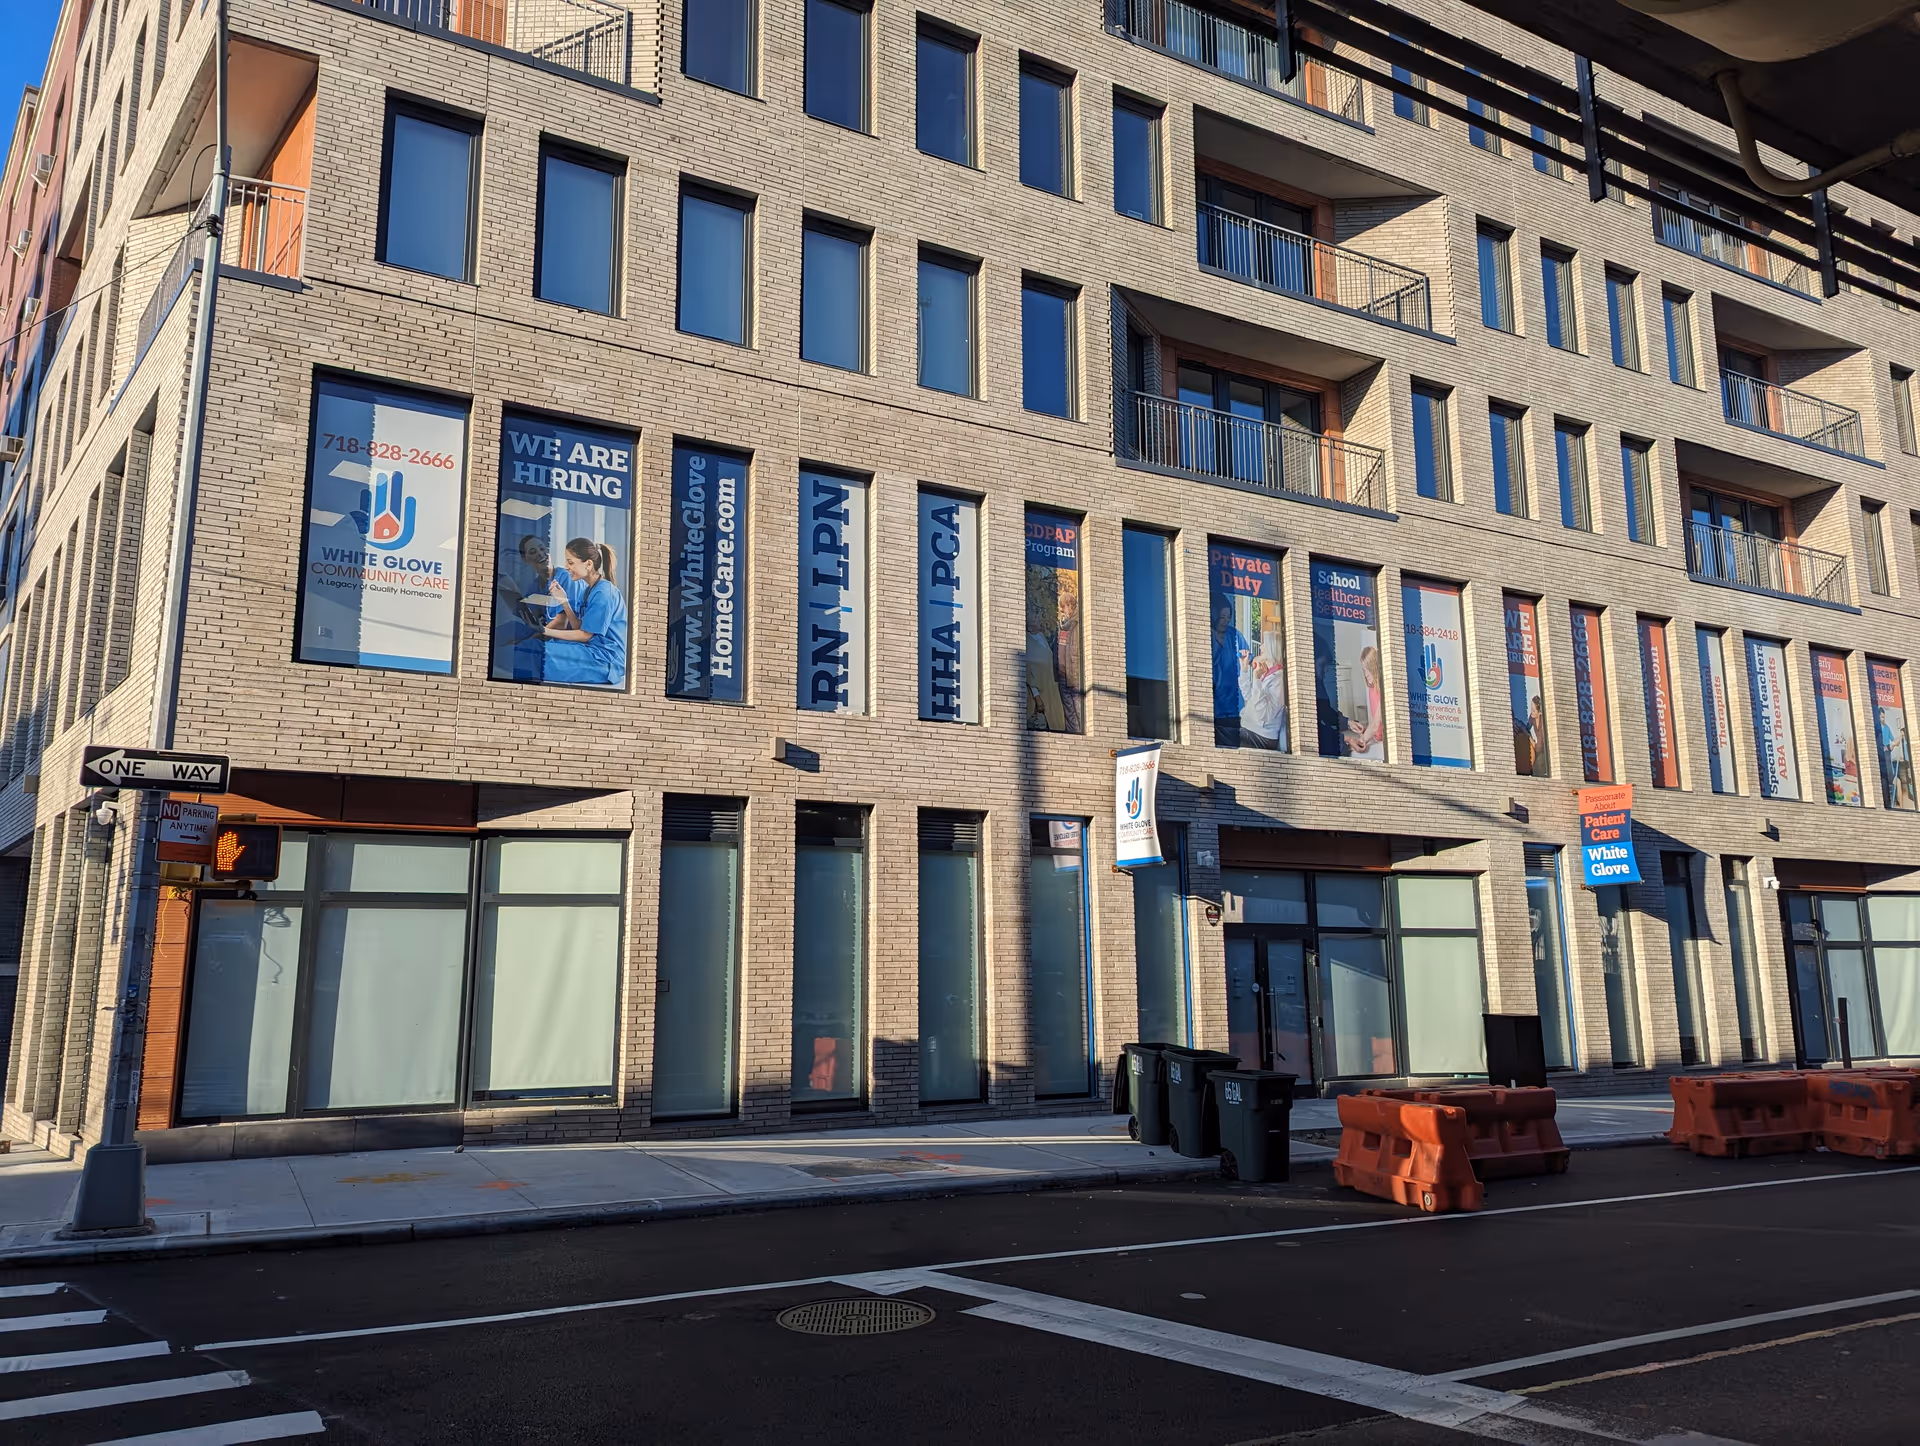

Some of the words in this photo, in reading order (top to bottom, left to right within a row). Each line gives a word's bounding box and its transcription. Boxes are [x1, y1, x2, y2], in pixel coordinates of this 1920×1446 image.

[323, 433, 455, 470] 718-828-2666
[508, 430, 561, 460] WE
[568, 441, 628, 473] ARE
[513, 459, 623, 500] HIRING
[812, 479, 850, 591] LPN
[930, 504, 961, 591] PCA
[321, 546, 378, 567] WHITE
[387, 555, 443, 575] GLOVE
[680, 455, 707, 691] www.WhiteGlove
[1211, 550, 1271, 575] Private
[311, 561, 407, 585] COMMUNITY
[410, 574, 449, 591] CARE
[326, 579, 358, 591] Legacy
[359, 583, 368, 591] of
[369, 584, 399, 598] Quality
[400, 588, 443, 600] Homecare
[710, 478, 735, 678] HomeCare.com
[1221, 571, 1262, 597] Duty
[1317, 570, 1361, 590] School
[1405, 623, 1459, 641] 18-384-2418
[811, 624, 849, 707] RN
[931, 620, 961, 718] HHA
[1508, 651, 1536, 665] IRING
[1756, 644, 1769, 711] Teachers
[1409, 692, 1432, 703] WHITE
[1434, 695, 1459, 706] GLOVE
[1572, 613, 1599, 777] 718-828-2666
[1651, 645, 1669, 760] Therapy.com
[1769, 657, 1783, 740] Therapists
[1704, 666, 1719, 756] Occupational
[1714, 676, 1728, 748] Therapists
[1763, 716, 1773, 736] Ed
[99, 759, 146, 777] ONE
[172, 765, 216, 781] WAY
[1765, 738, 1779, 795] Special
[1776, 744, 1788, 780] ABA
[163, 802, 180, 818] NO
[182, 807, 215, 820] PARKING
[1584, 790, 1626, 804] Passionate
[1593, 801, 1616, 811] About
[169, 822, 208, 833] ANYTIME
[1134, 819, 1151, 828] GLOVE
[1584, 812, 1626, 828] Patient
[1591, 827, 1620, 842] Care
[1587, 845, 1628, 862] White
[1591, 861, 1630, 878] Glove
